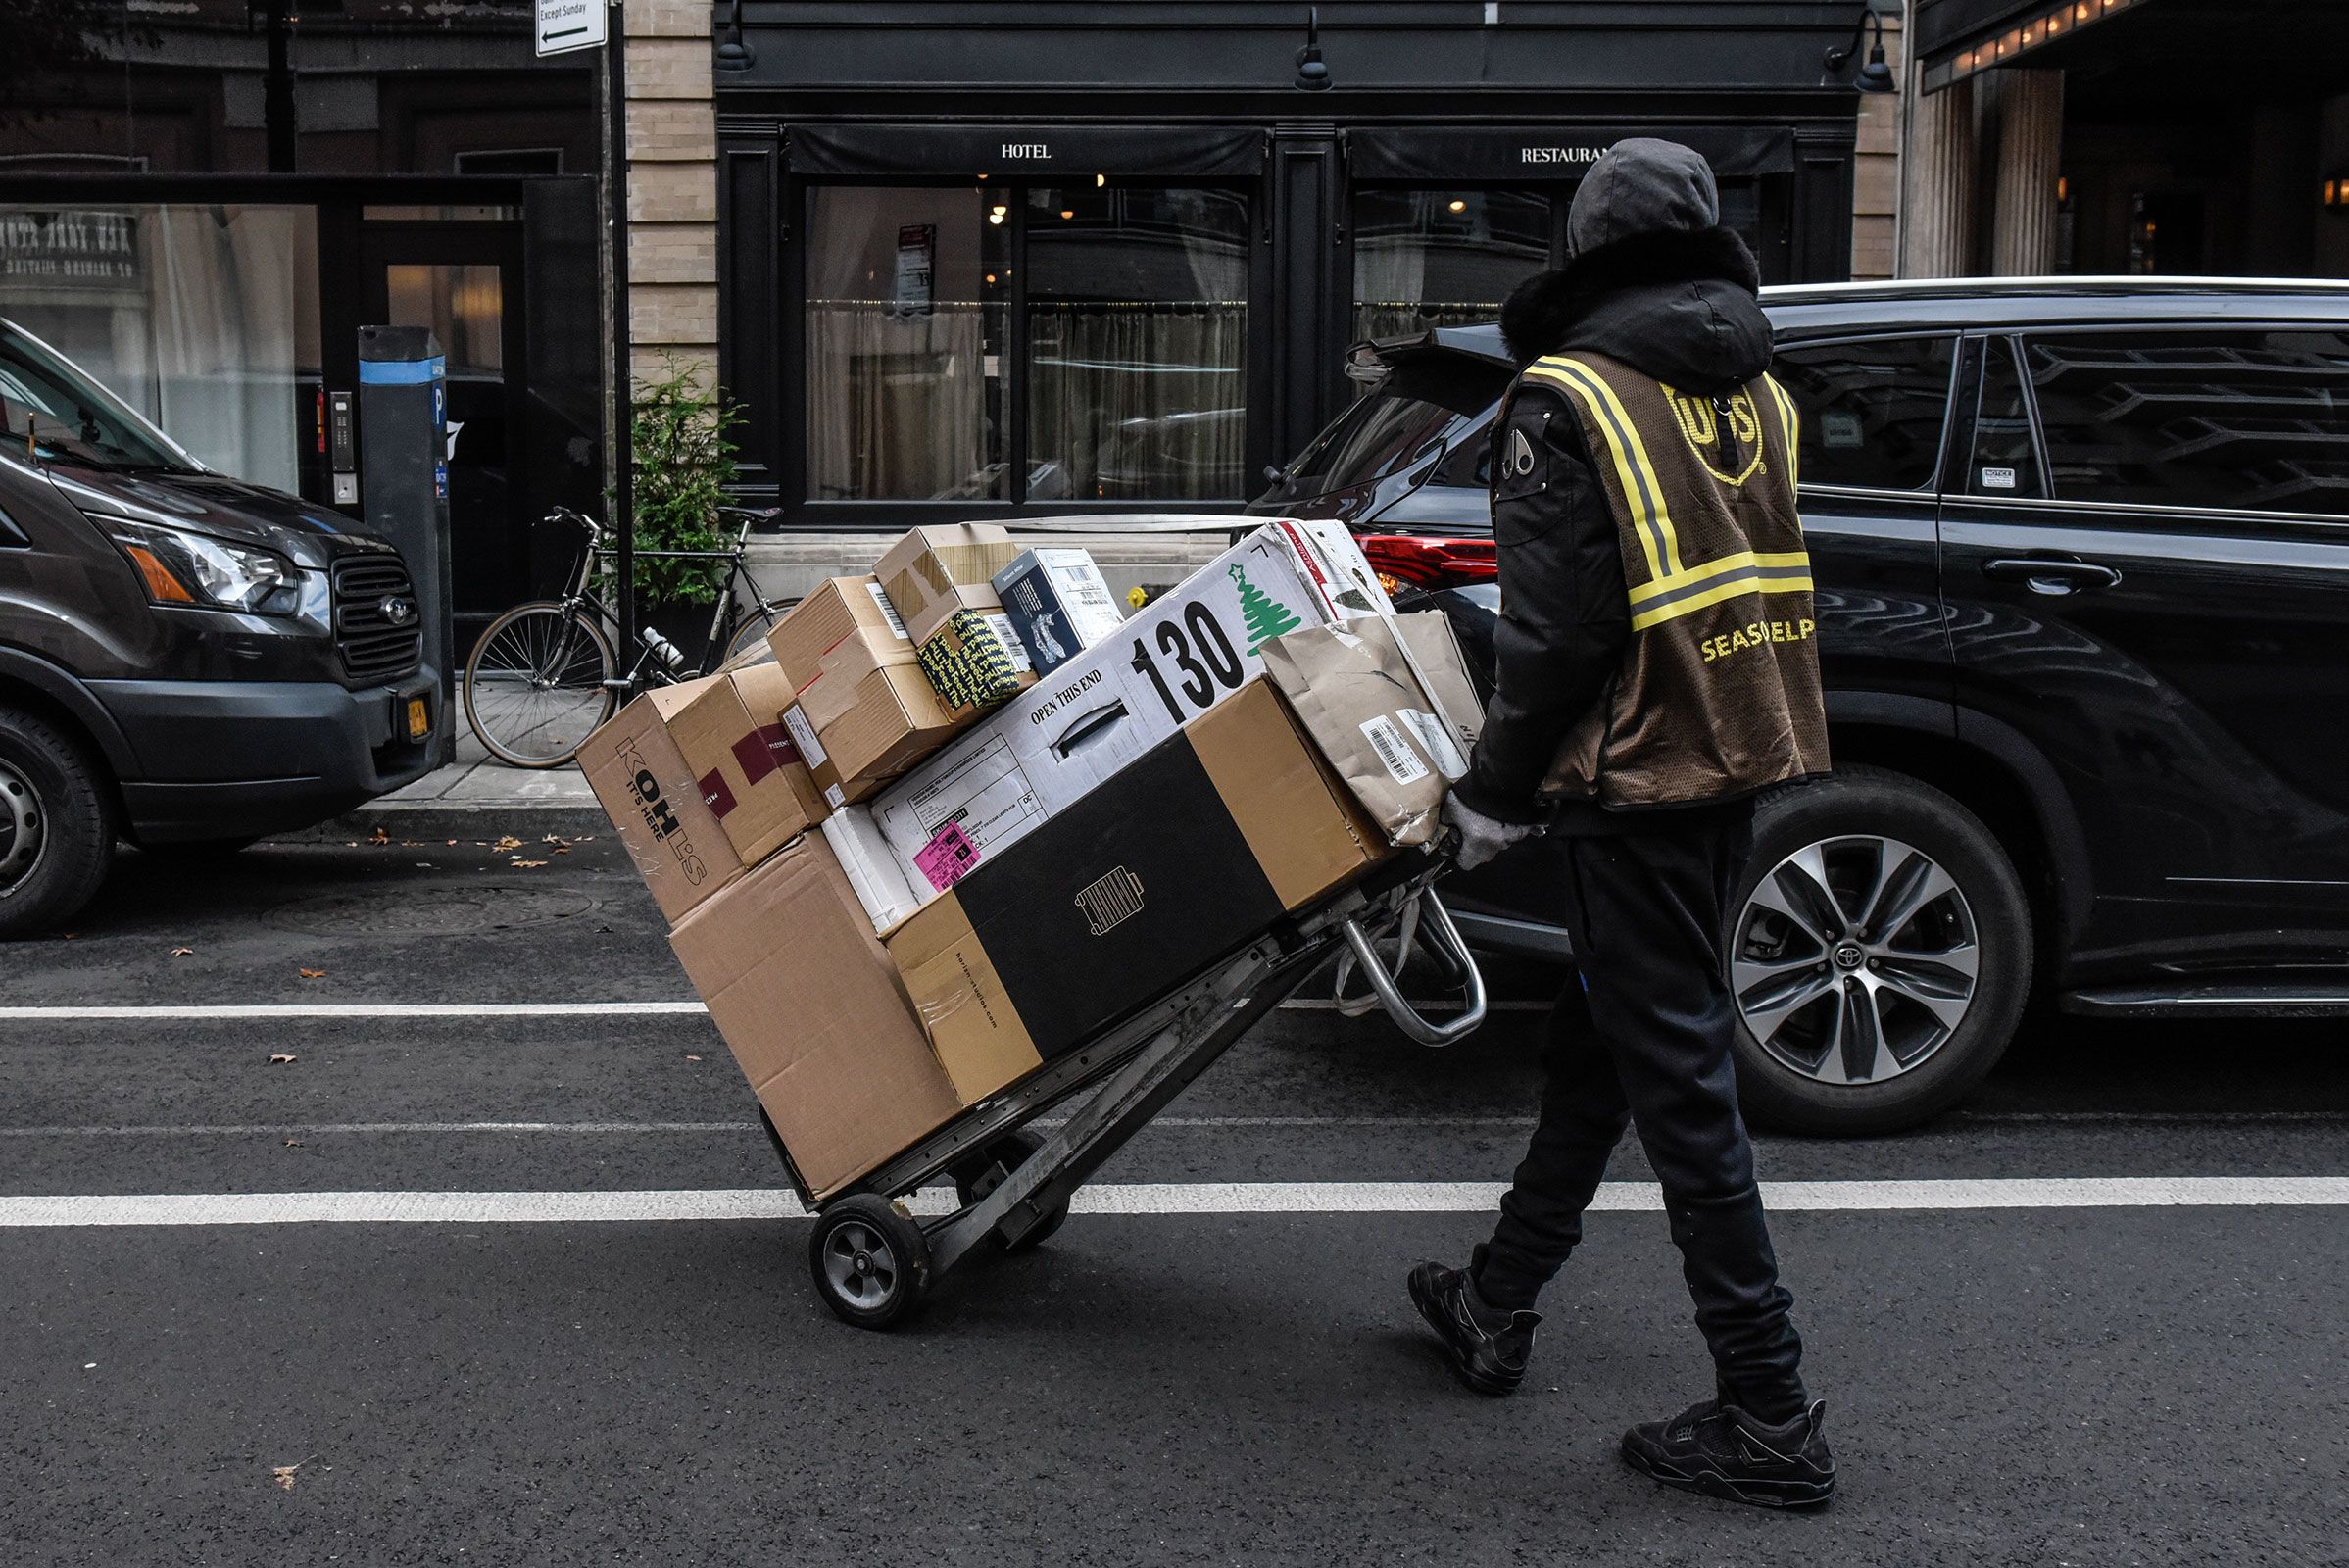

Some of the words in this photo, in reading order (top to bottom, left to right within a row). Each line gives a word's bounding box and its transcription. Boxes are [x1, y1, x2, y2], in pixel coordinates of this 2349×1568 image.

[540, 8, 562, 21] Except
[563, 4, 586, 16] Sunday
[1002, 144, 1052, 159] HOTEL
[1521, 148, 1608, 163] RESTAURA
[435, 388, 443, 425] P
[1130, 600, 1245, 726] 130
[1030, 699, 1060, 726] OPEN
[1055, 680, 1083, 710] THIS
[1080, 668, 1103, 692] END
[614, 736, 708, 887] KOHL'S
[625, 780, 645, 807] IT'S
[640, 805, 665, 844] HERE
[1023, 795, 1032, 804] DC
